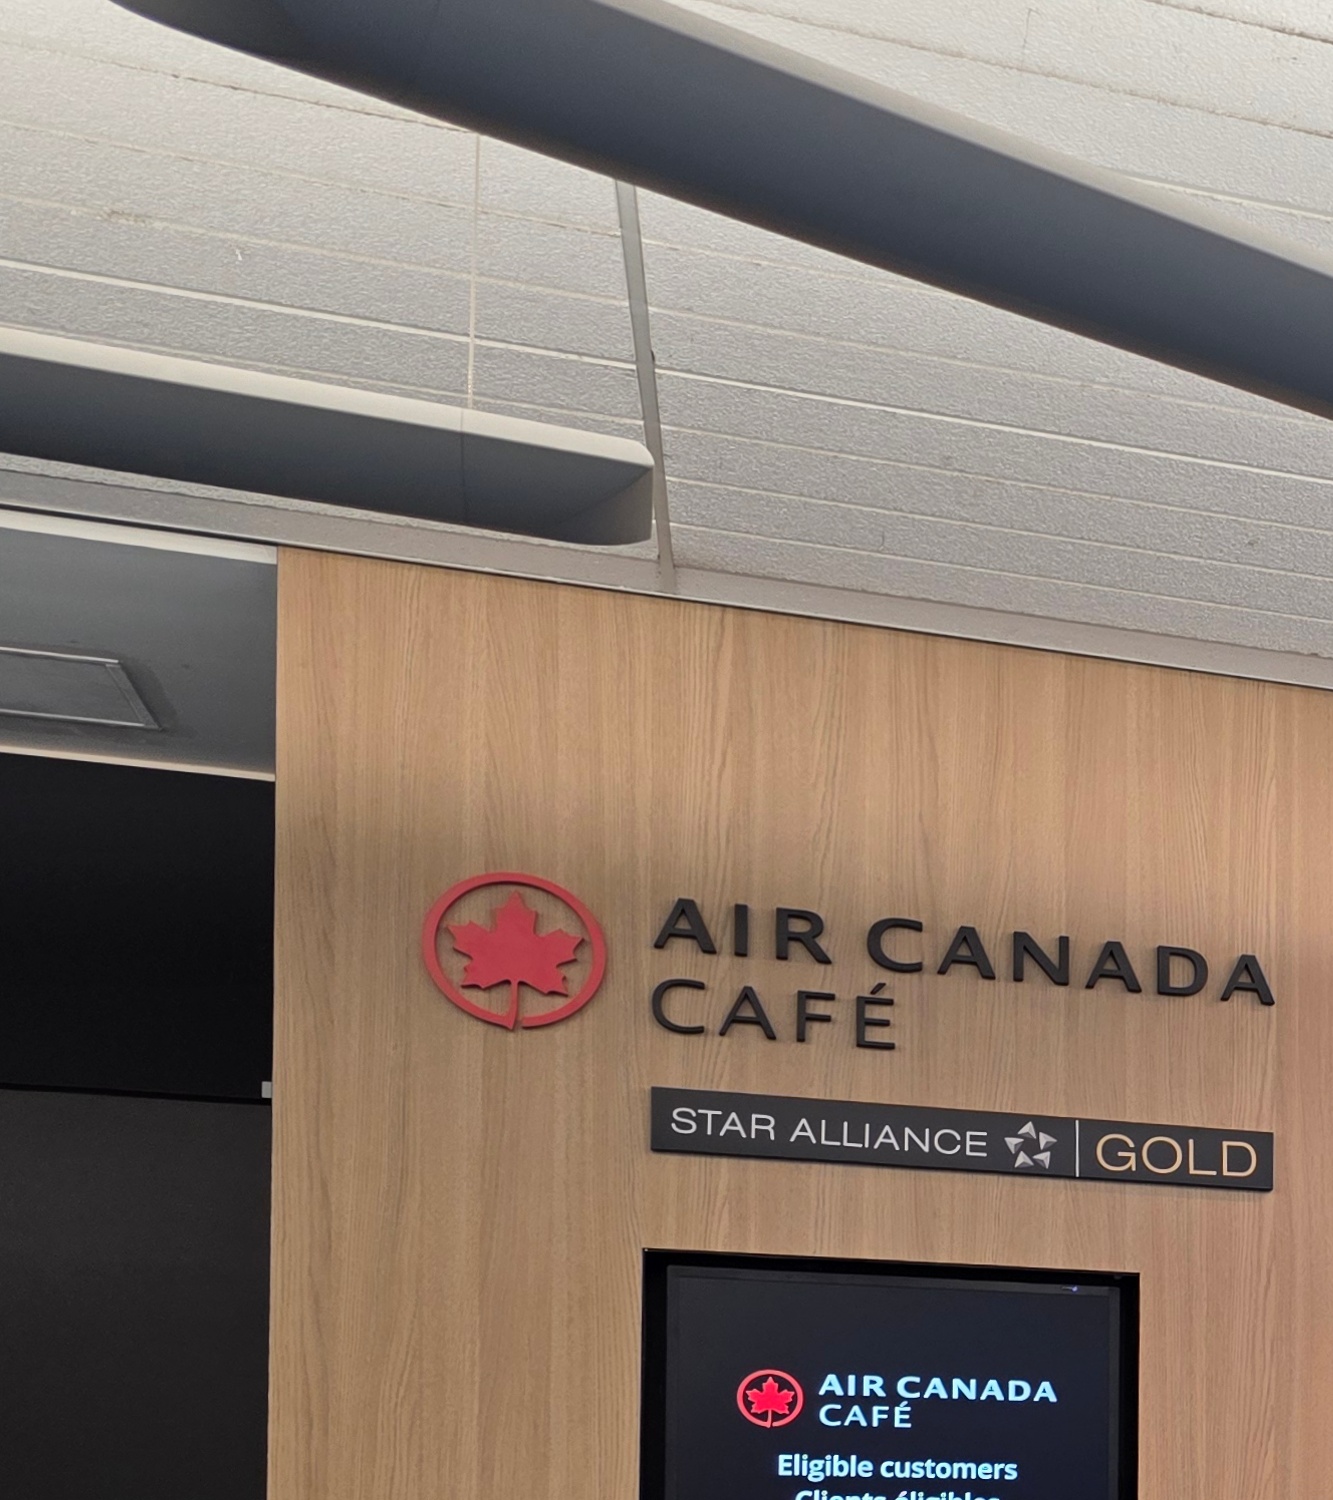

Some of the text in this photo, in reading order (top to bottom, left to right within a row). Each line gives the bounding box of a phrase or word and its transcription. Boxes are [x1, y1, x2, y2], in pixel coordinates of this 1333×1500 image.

[653, 897, 1275, 1006] AIR CANADA
[651, 977, 896, 1051] CAFÉ
[670, 1107, 1258, 1179] STAR ALLIANCE GOLD
[818, 1374, 1059, 1403] AIR CANADA
[818, 1401, 912, 1428] CAFÉ
[777, 1454, 1018, 1482] Eligible customers
